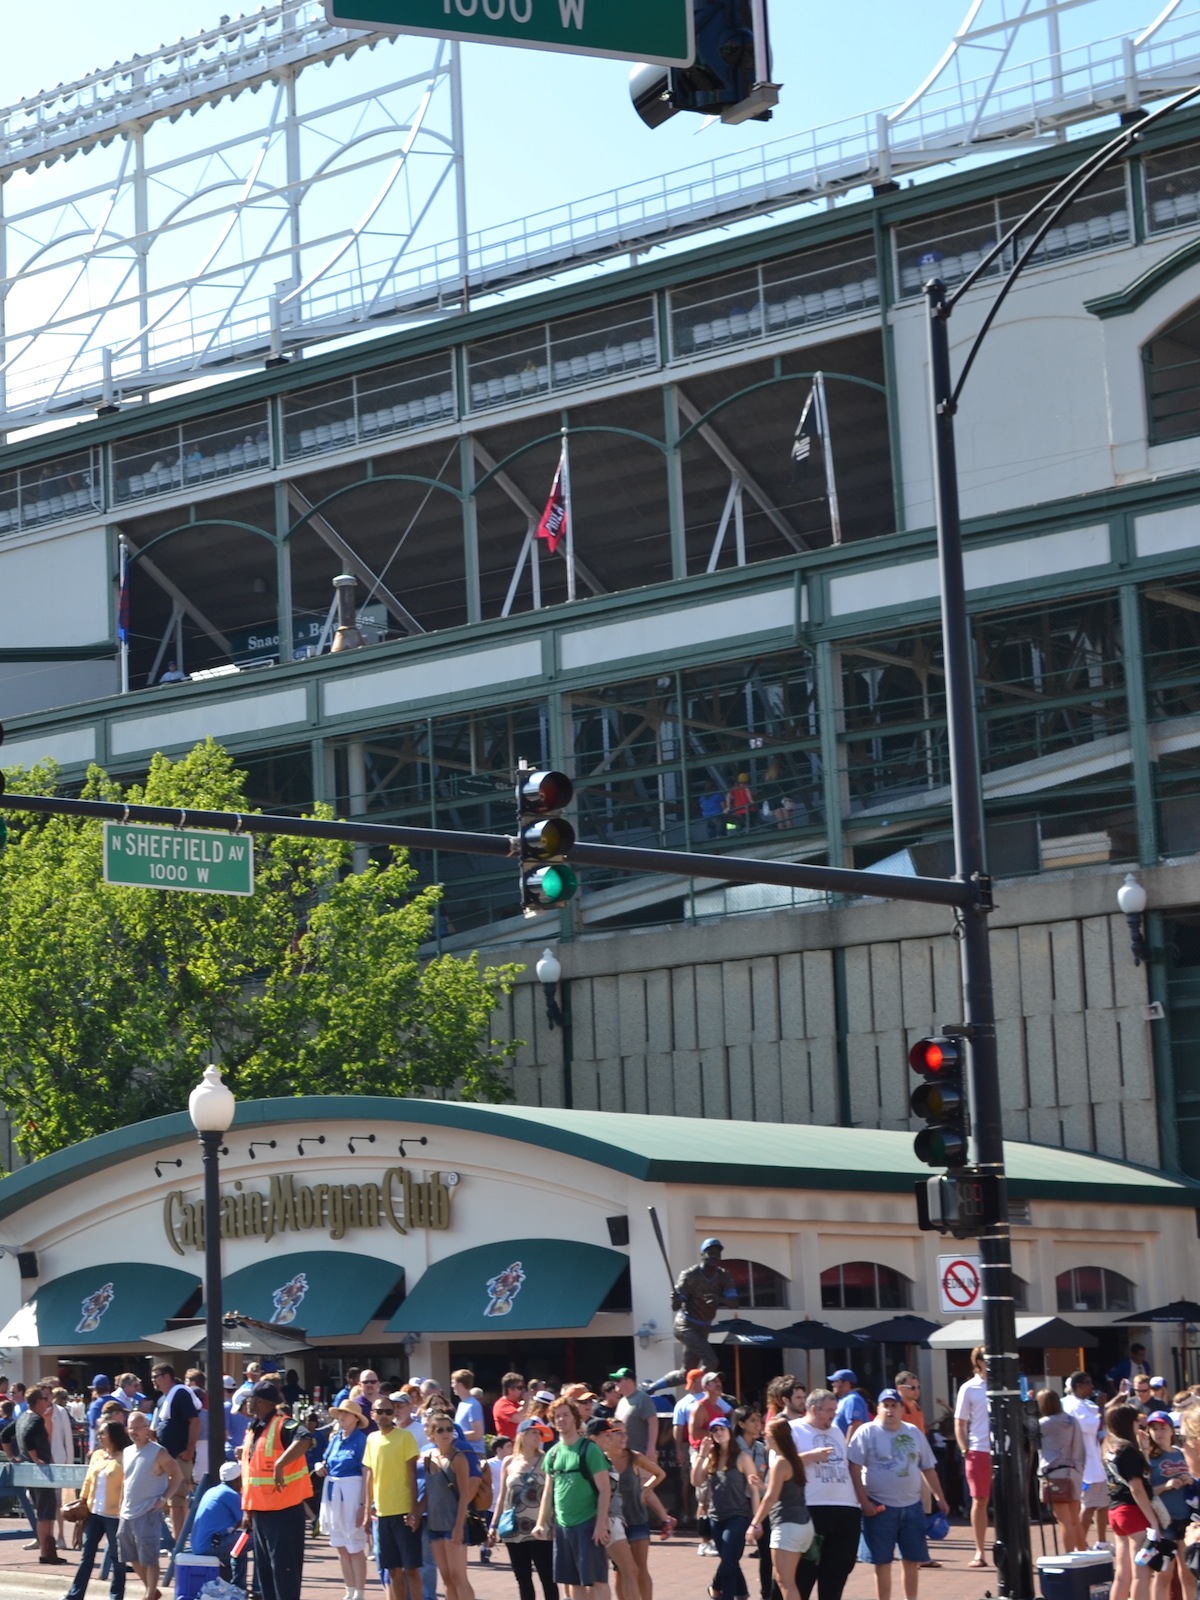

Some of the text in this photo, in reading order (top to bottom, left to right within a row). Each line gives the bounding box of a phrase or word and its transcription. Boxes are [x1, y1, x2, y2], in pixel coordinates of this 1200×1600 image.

[558, 0, 585, 30] W
[112, 833, 244, 863] N SHEFFIELD AV
[150, 863, 210, 883] 1000 W
[163, 1167, 451, 1256] Capain Morgan Club
